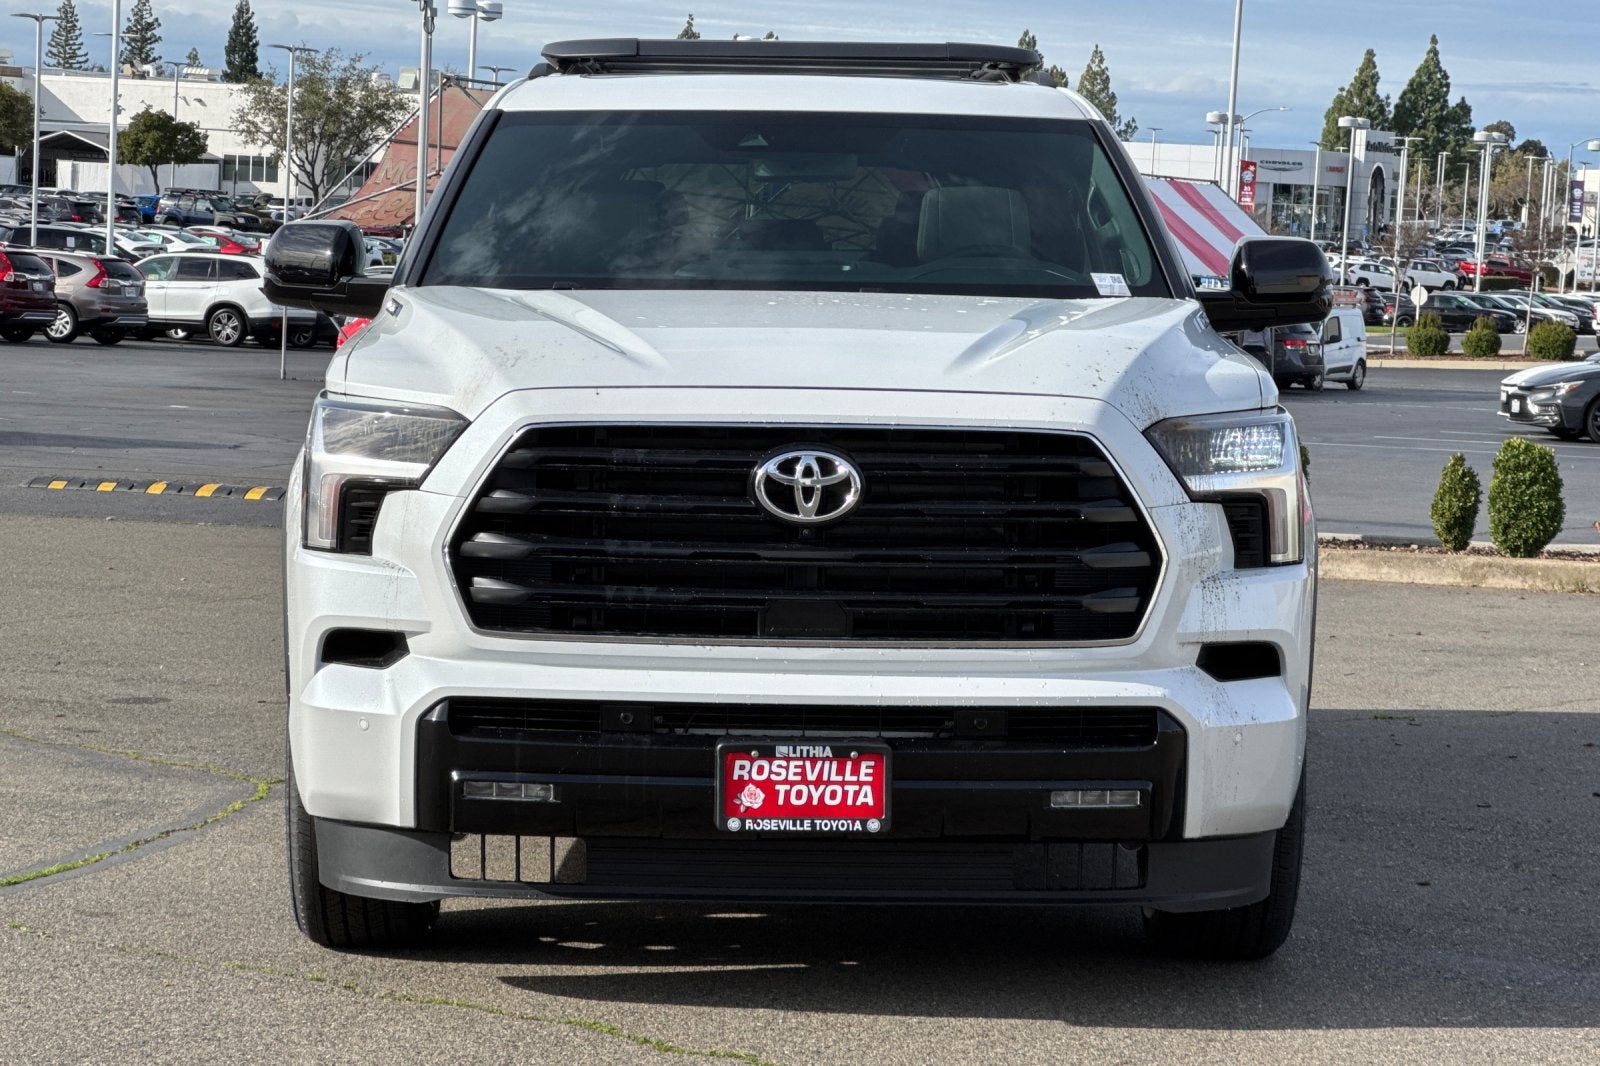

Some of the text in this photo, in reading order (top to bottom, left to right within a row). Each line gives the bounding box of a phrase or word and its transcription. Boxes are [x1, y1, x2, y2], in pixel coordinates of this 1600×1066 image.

[788, 746, 833, 758] LITHIA
[732, 759, 875, 782] ROSEVILLE
[775, 784, 874, 806] TOYOTA
[745, 819, 862, 832] ROSEVILLE TOYOTA
